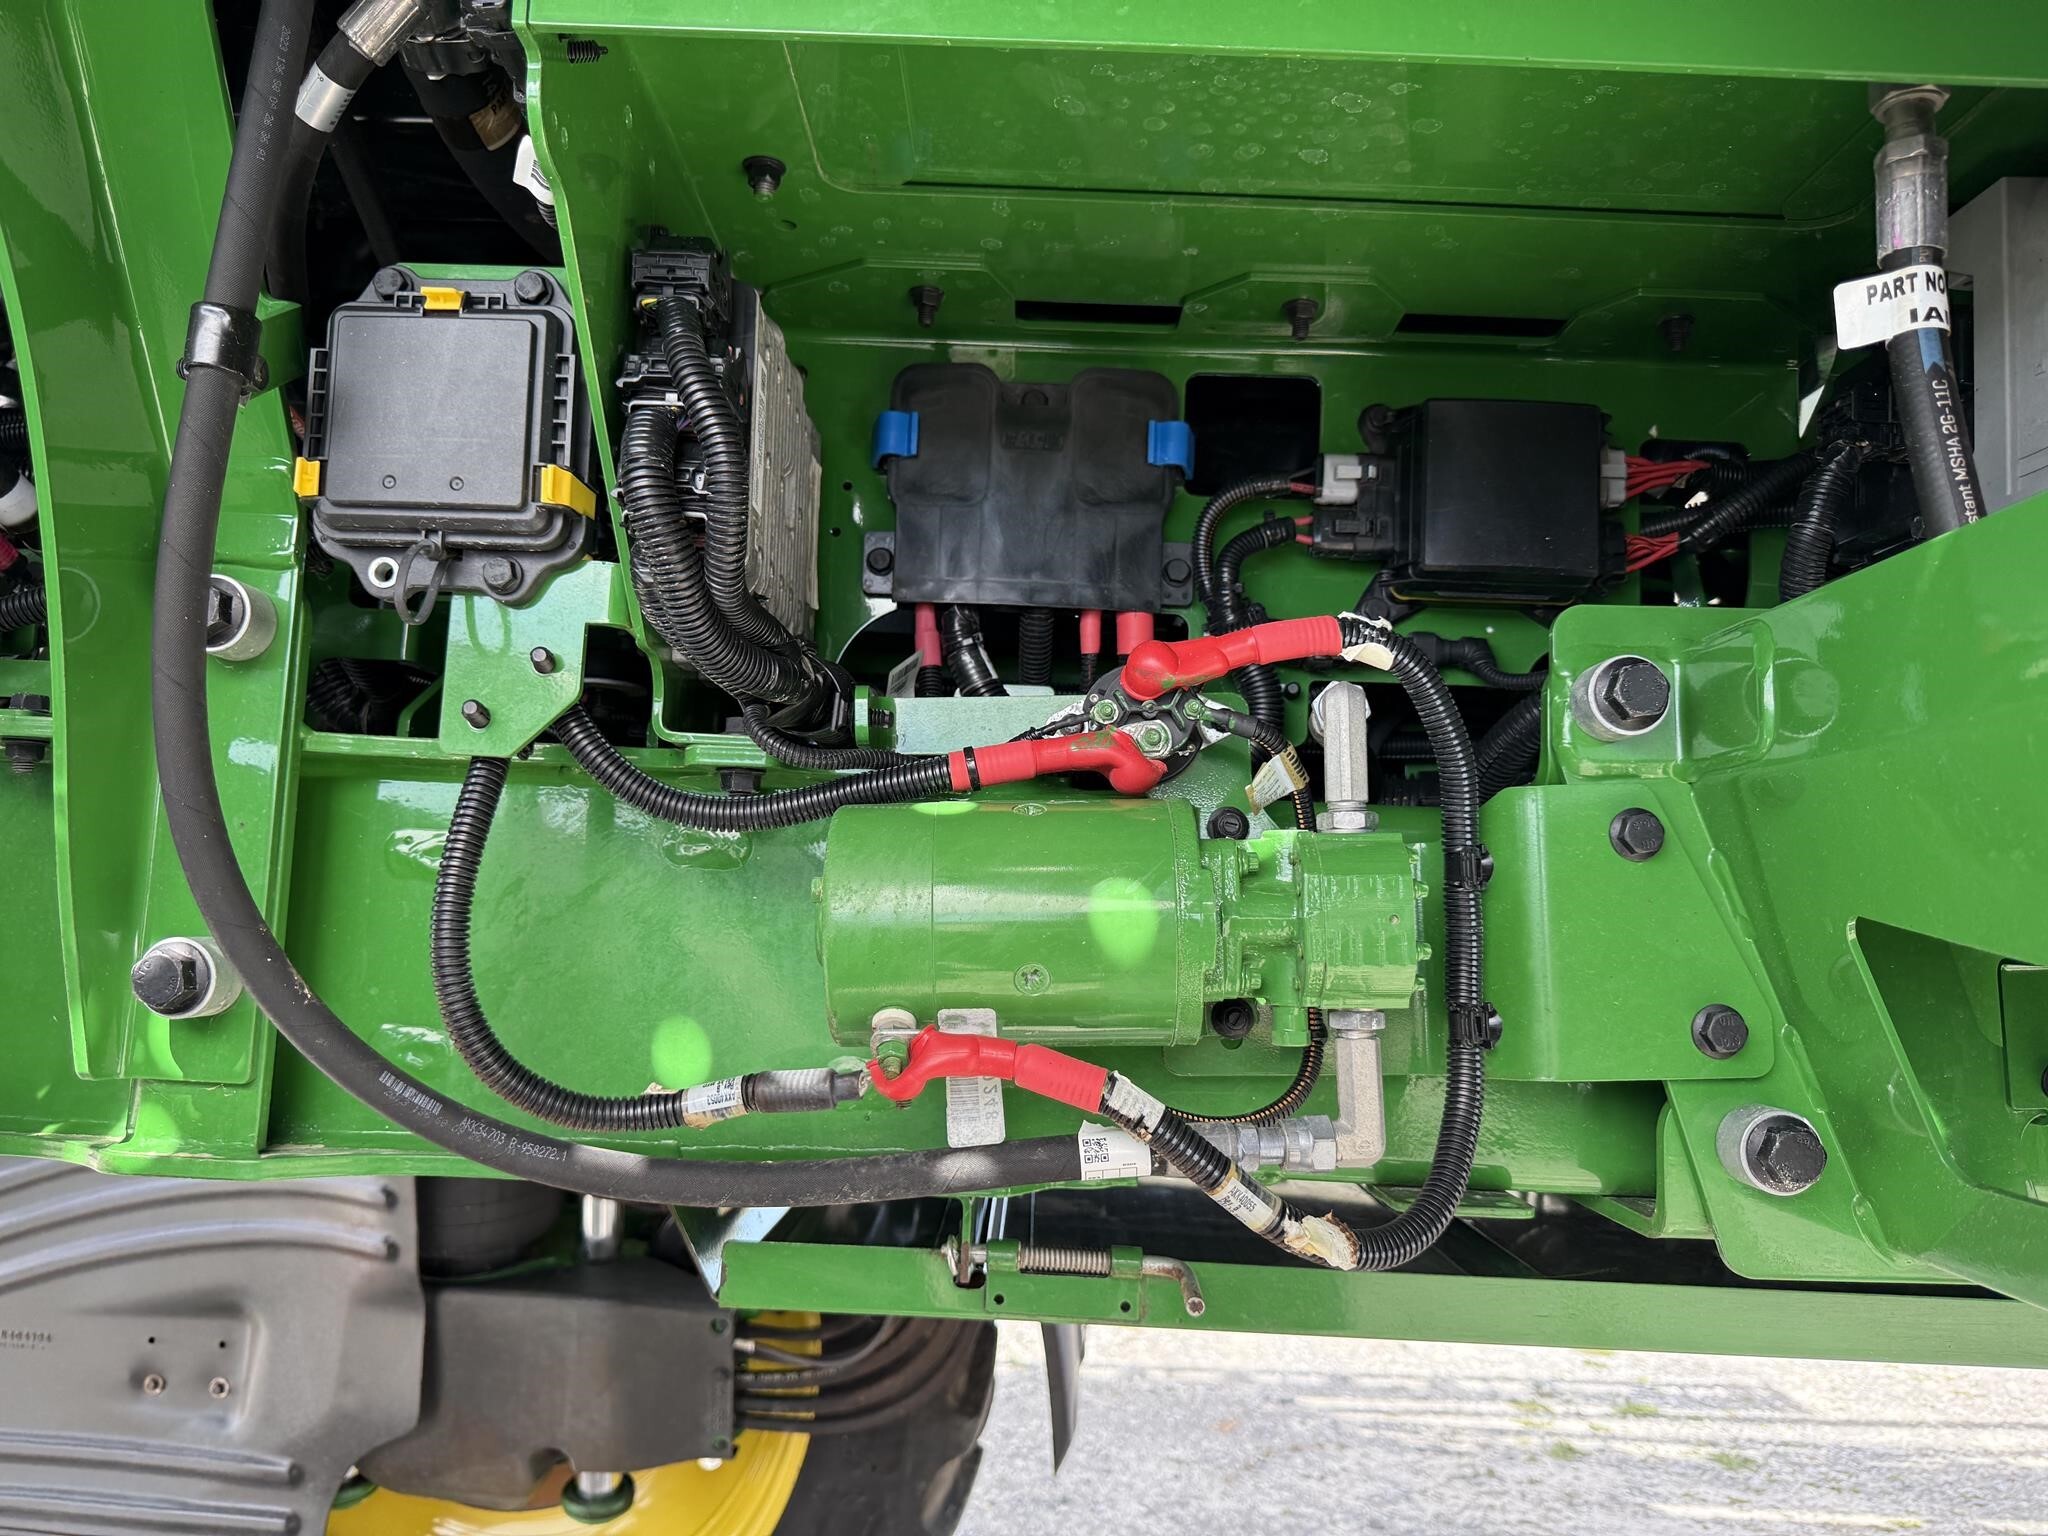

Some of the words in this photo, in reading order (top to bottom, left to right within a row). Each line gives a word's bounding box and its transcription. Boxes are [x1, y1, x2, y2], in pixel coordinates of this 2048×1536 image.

[1866, 272, 1918, 306] PART
[1931, 379, 1958, 434] 2G-11C
[1945, 436, 1969, 481] MSHA
[459, 1116, 507, 1146] AKK34703
[1228, 1185, 1257, 1212] AKK40055
